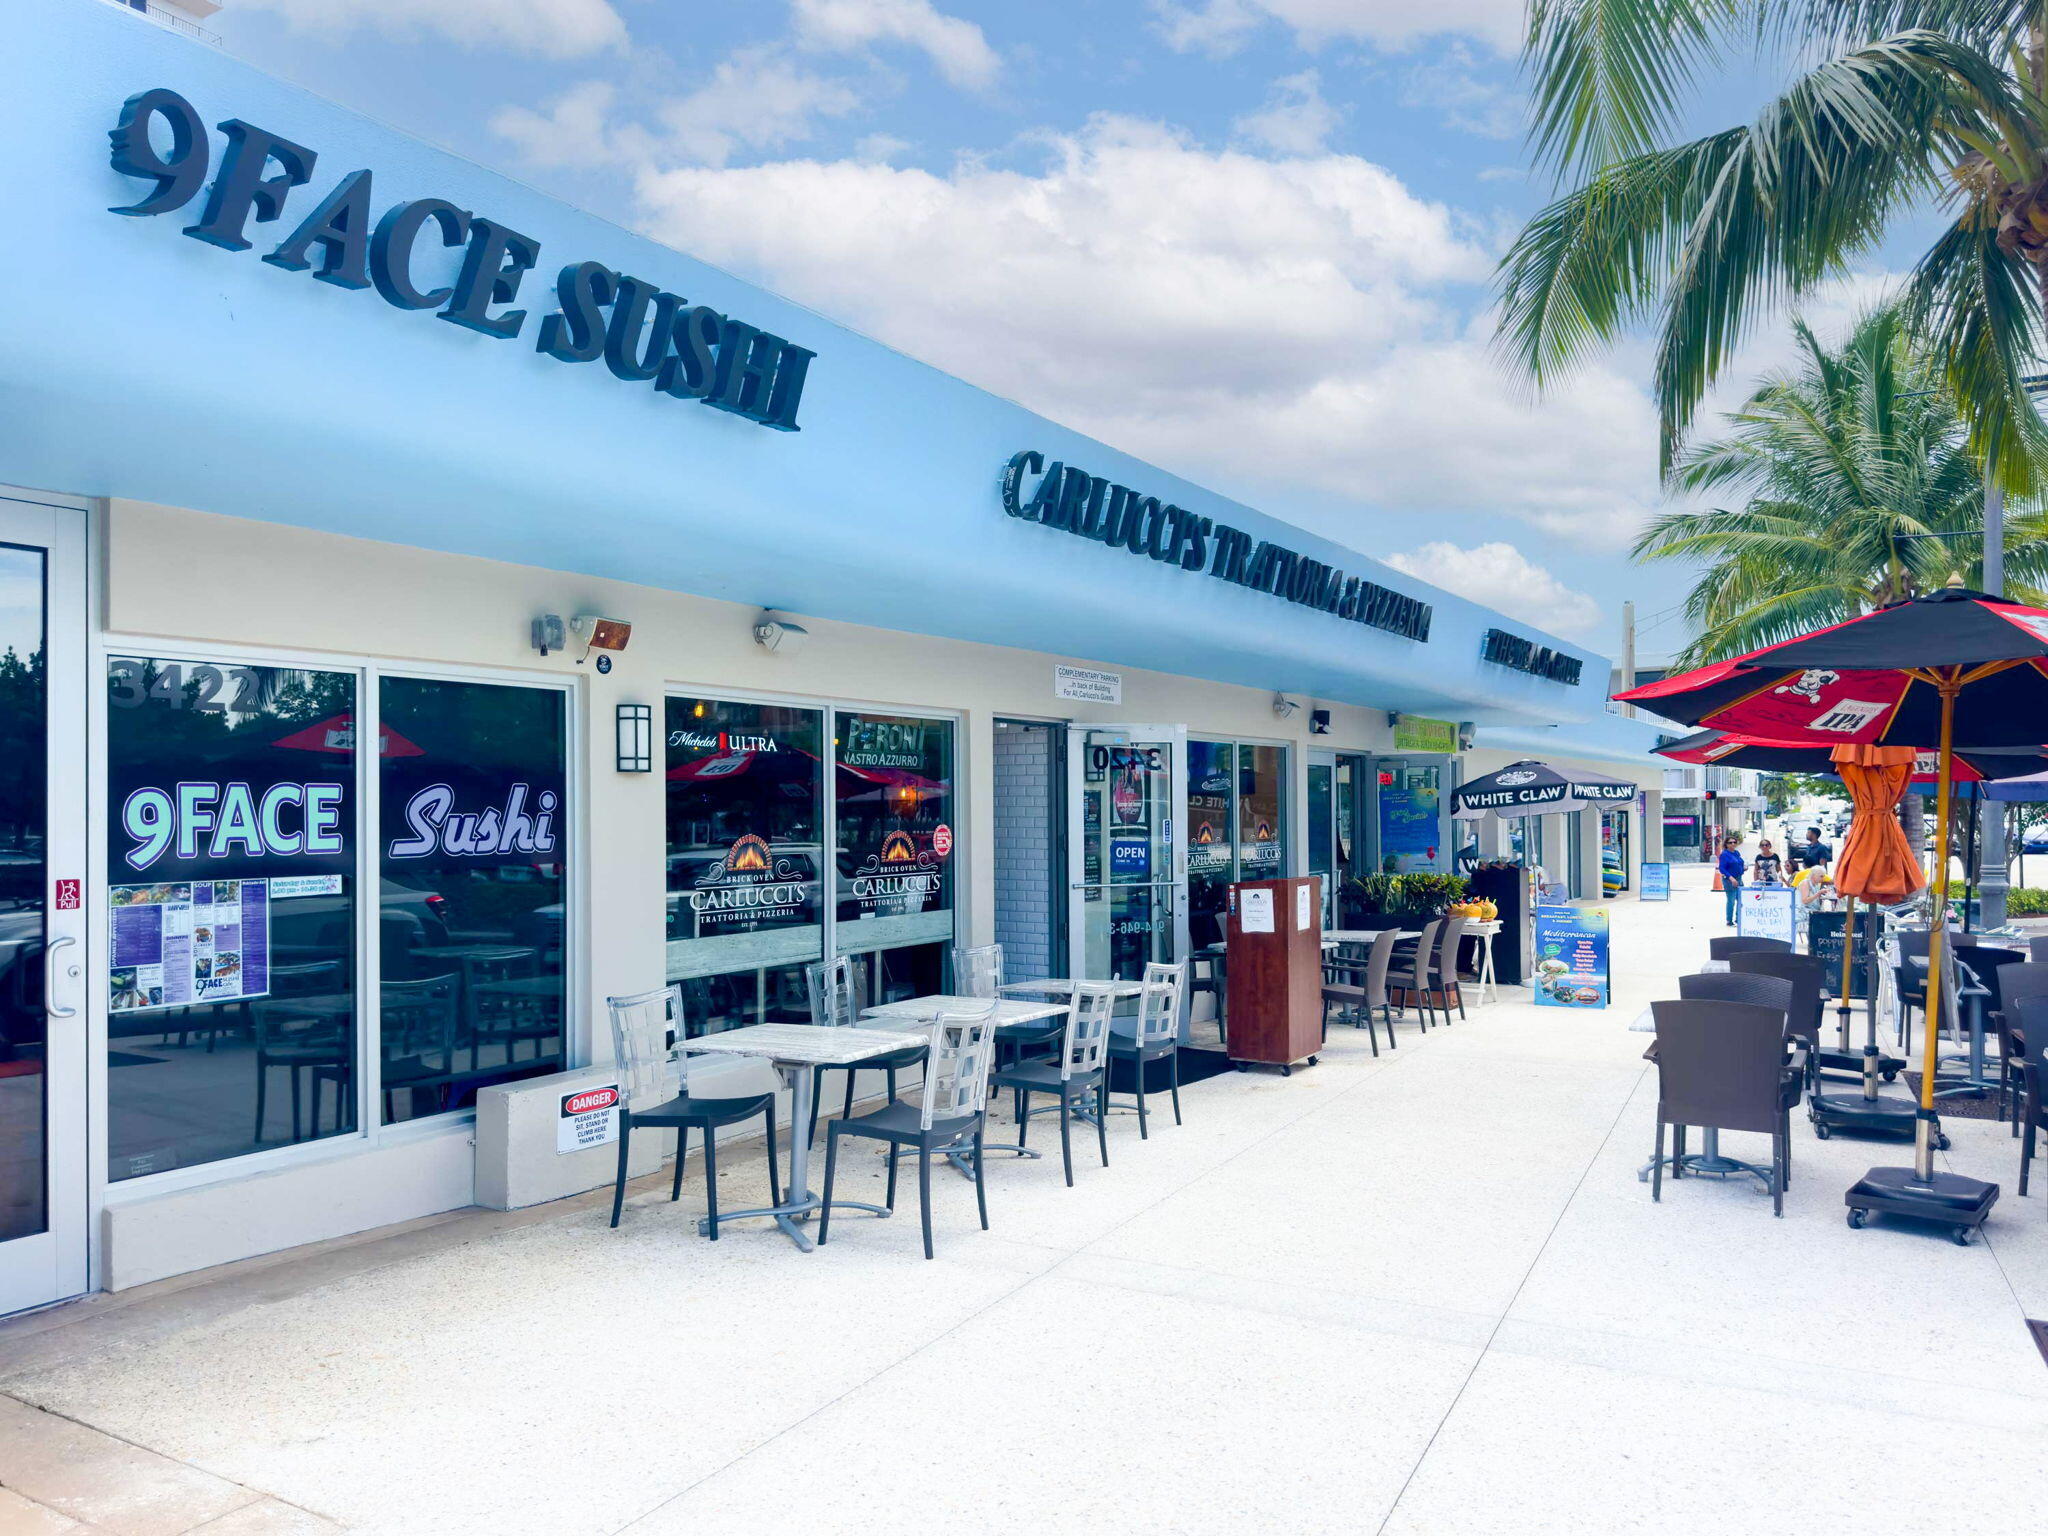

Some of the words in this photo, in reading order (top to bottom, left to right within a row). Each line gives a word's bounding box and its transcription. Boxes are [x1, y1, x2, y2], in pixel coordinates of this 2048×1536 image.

[108, 88, 541, 339] 9FACE
[536, 260, 818, 433] SUSHI
[1002, 450, 1213, 571] CARLUCCI'S
[1337, 576, 1360, 619] &
[107, 659, 262, 711] 3422
[1100, 674, 1119, 684] PARKING
[1819, 712, 1866, 729] IPA
[669, 731, 717, 747] Michelob
[729, 735, 777, 752] ULTRA
[848, 719, 926, 751] PERONI
[844, 752, 877, 765] NASTRO
[878, 752, 918, 767] AZZURRO
[1466, 791, 1513, 806] WHITE
[1519, 786, 1561, 802] CLAW
[1574, 785, 1601, 797] WHITE
[1602, 786, 1632, 798] CLAW
[123, 782, 342, 870] 9FACE
[389, 783, 557, 858] Sushi
[1116, 847, 1146, 858] OPEN
[880, 865, 899, 873] BRICK
[900, 864, 917, 872] OVEN
[726, 875, 751, 883] BRICK
[753, 873, 775, 882] OVEN
[852, 874, 941, 896] CARLUCCI'S
[60, 900, 77, 909] Pull
[689, 884, 806, 911] CARLUCCI'S
[700, 912, 748, 924] TRATTORIA
[750, 911, 757, 919] &
[757, 909, 794, 919] PIZZERIA
[1542, 929, 1597, 939] Mediterranean
[572, 1091, 612, 1111] DANGER
[574, 1115, 592, 1123] PLEASE
[585, 1121, 601, 1129] STAND
[577, 1129, 593, 1138] CLIMB
[578, 1136, 594, 1144] THANK
